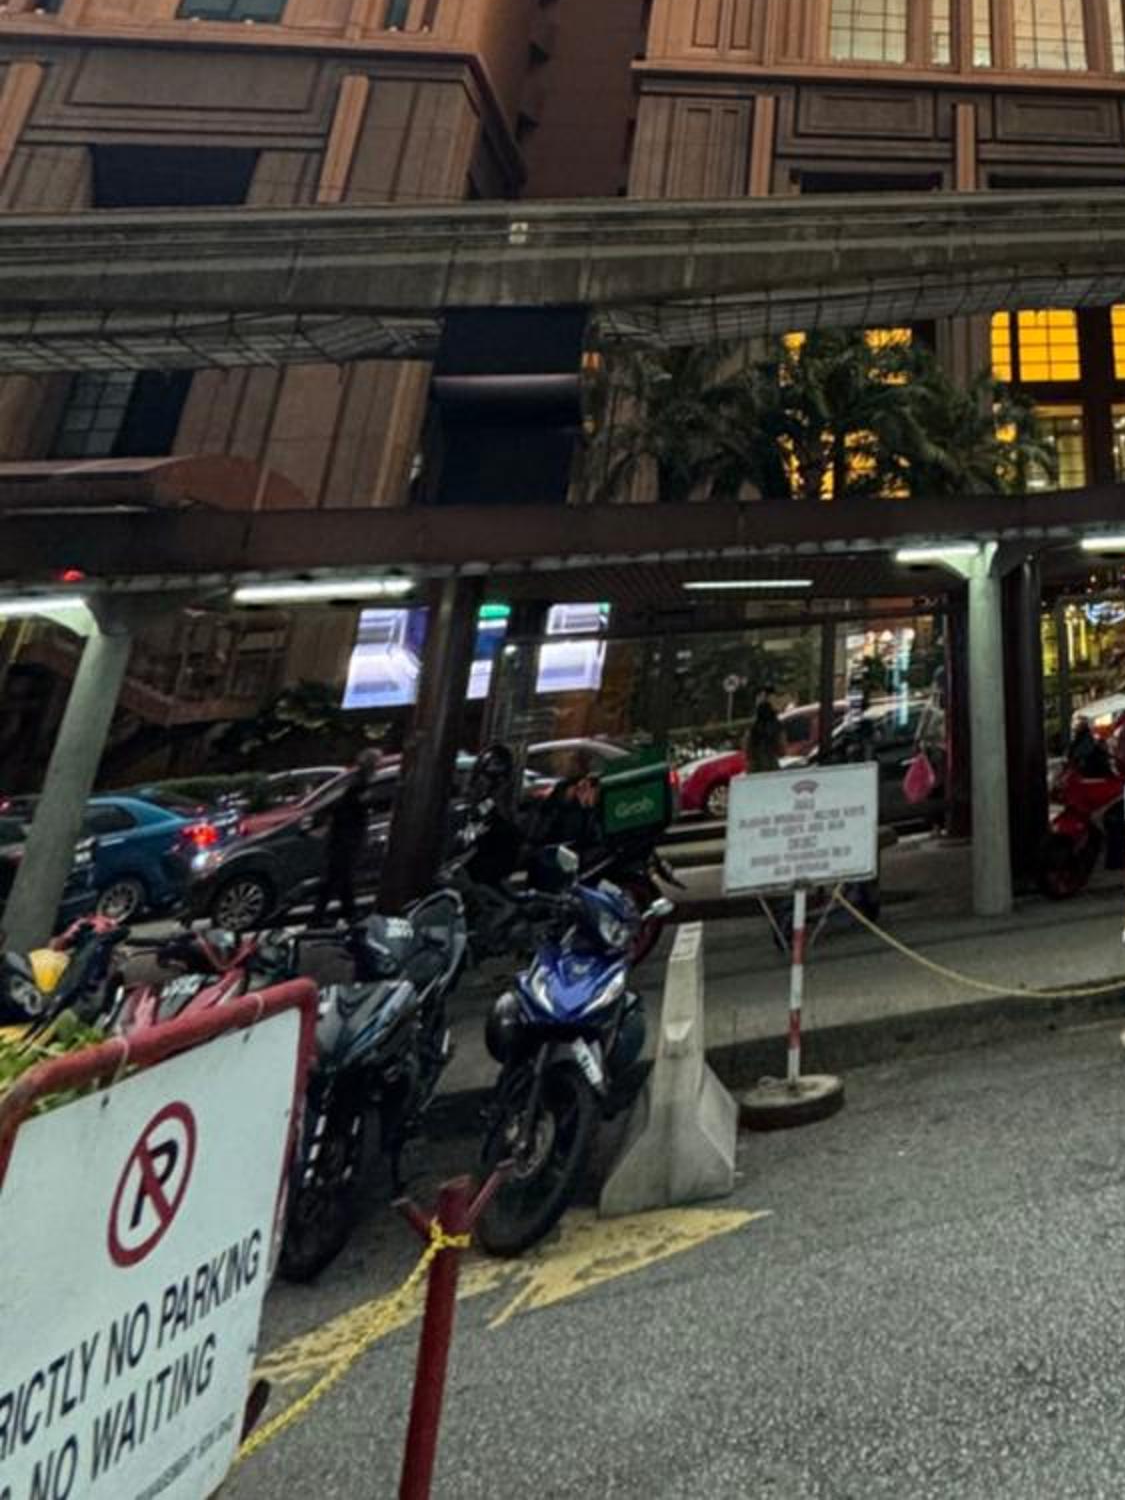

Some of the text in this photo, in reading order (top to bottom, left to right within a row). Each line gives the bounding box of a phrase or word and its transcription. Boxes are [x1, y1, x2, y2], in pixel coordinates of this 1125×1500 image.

[103, 1301, 151, 1386] NO
[157, 1228, 262, 1349] PARKING
[29, 1434, 79, 1500] NO
[90, 1332, 216, 1482] WAITING
